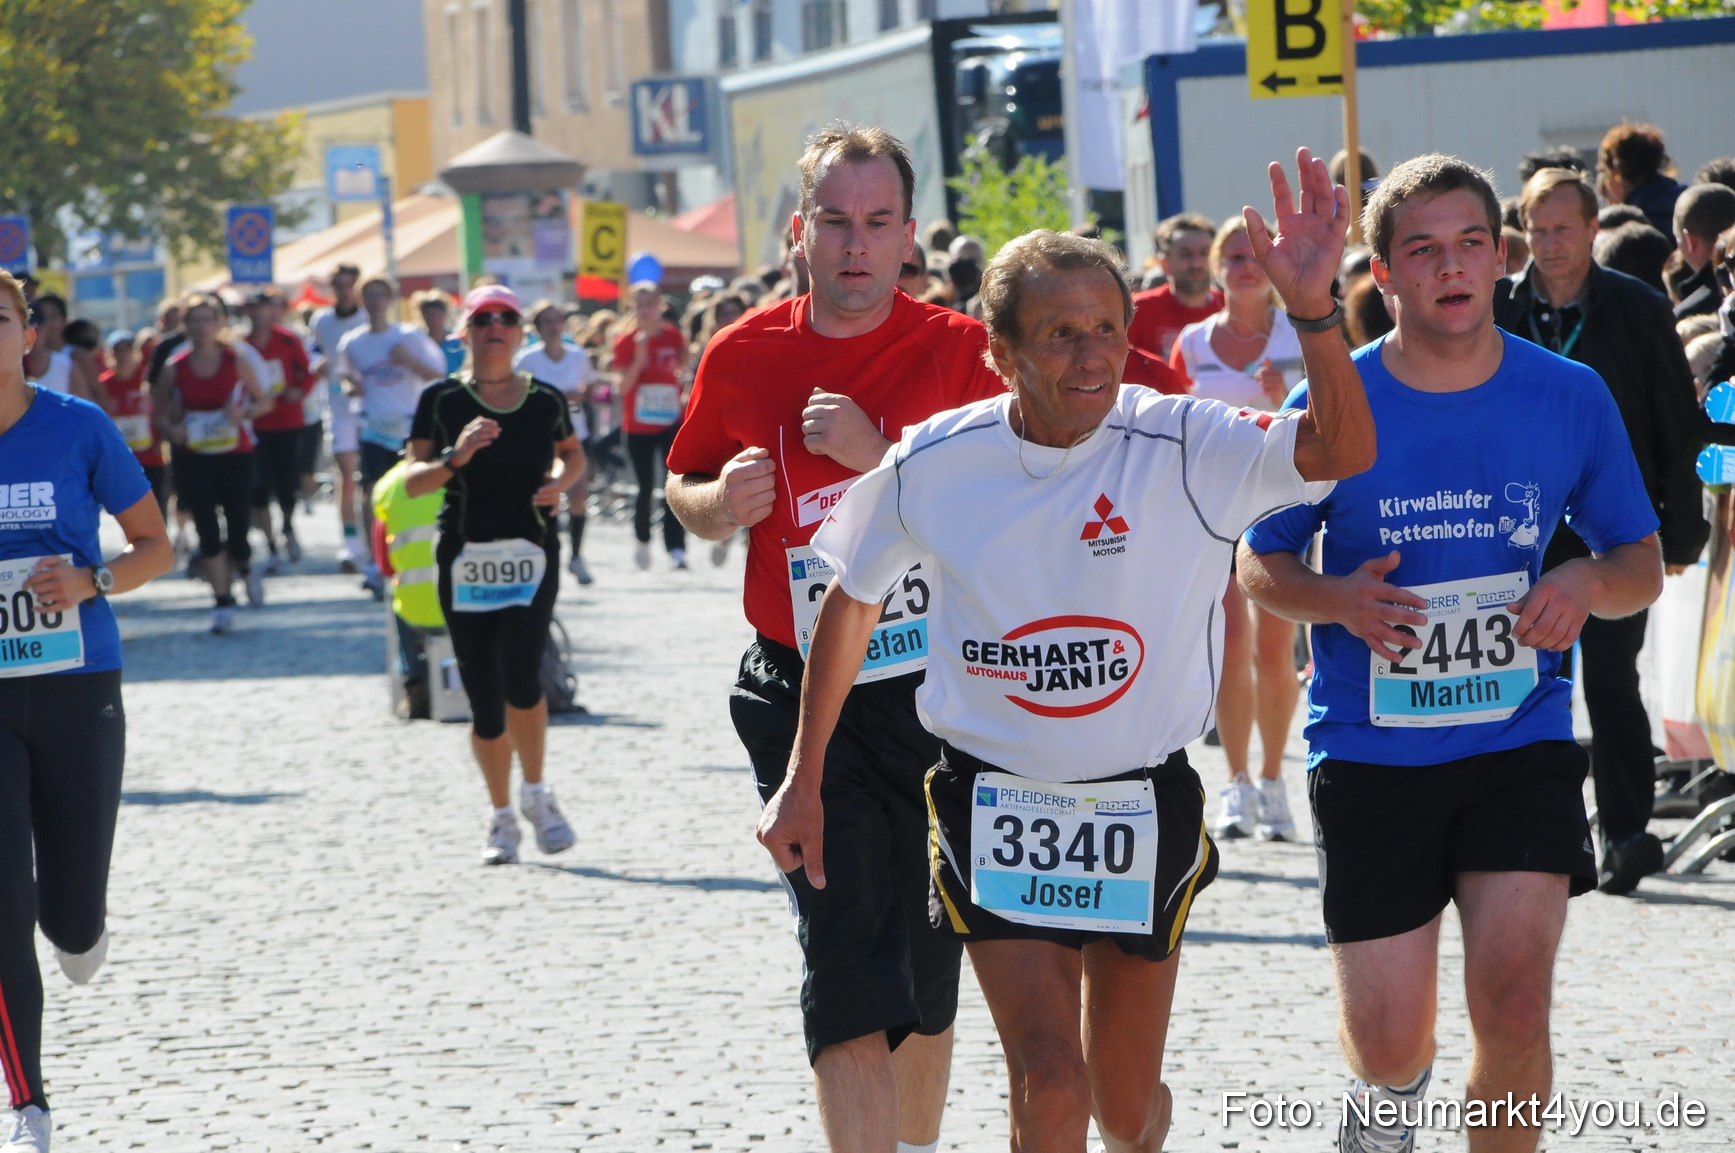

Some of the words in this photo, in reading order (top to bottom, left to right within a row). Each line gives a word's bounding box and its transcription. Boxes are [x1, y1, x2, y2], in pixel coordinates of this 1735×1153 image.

[1275, 0, 1326, 60] B
[591, 224, 616, 261] C
[1379, 489, 1493, 518] Kirwaläufer
[1088, 535, 1127, 548] MITSUBISHI
[1380, 519, 1495, 546] Pettenhofen
[1093, 546, 1126, 557] MOTORS
[463, 560, 534, 583] 3090
[962, 639, 1110, 668] GERHART
[1112, 640, 1125, 655] &
[1390, 614, 1515, 675] 2443
[966, 665, 1027, 681] AUTOHAUS
[1026, 658, 1129, 692] JÄNIG
[1411, 675, 1500, 708] Martin
[1000, 788, 1077, 808] PFLEIDERER
[1095, 799, 1141, 811] BOCK
[1000, 803, 1076, 816] AKTIENGESELLSCHAFT
[992, 814, 1135, 874] 3340
[979, 857, 986, 866] B
[1021, 876, 1103, 910] Josef
